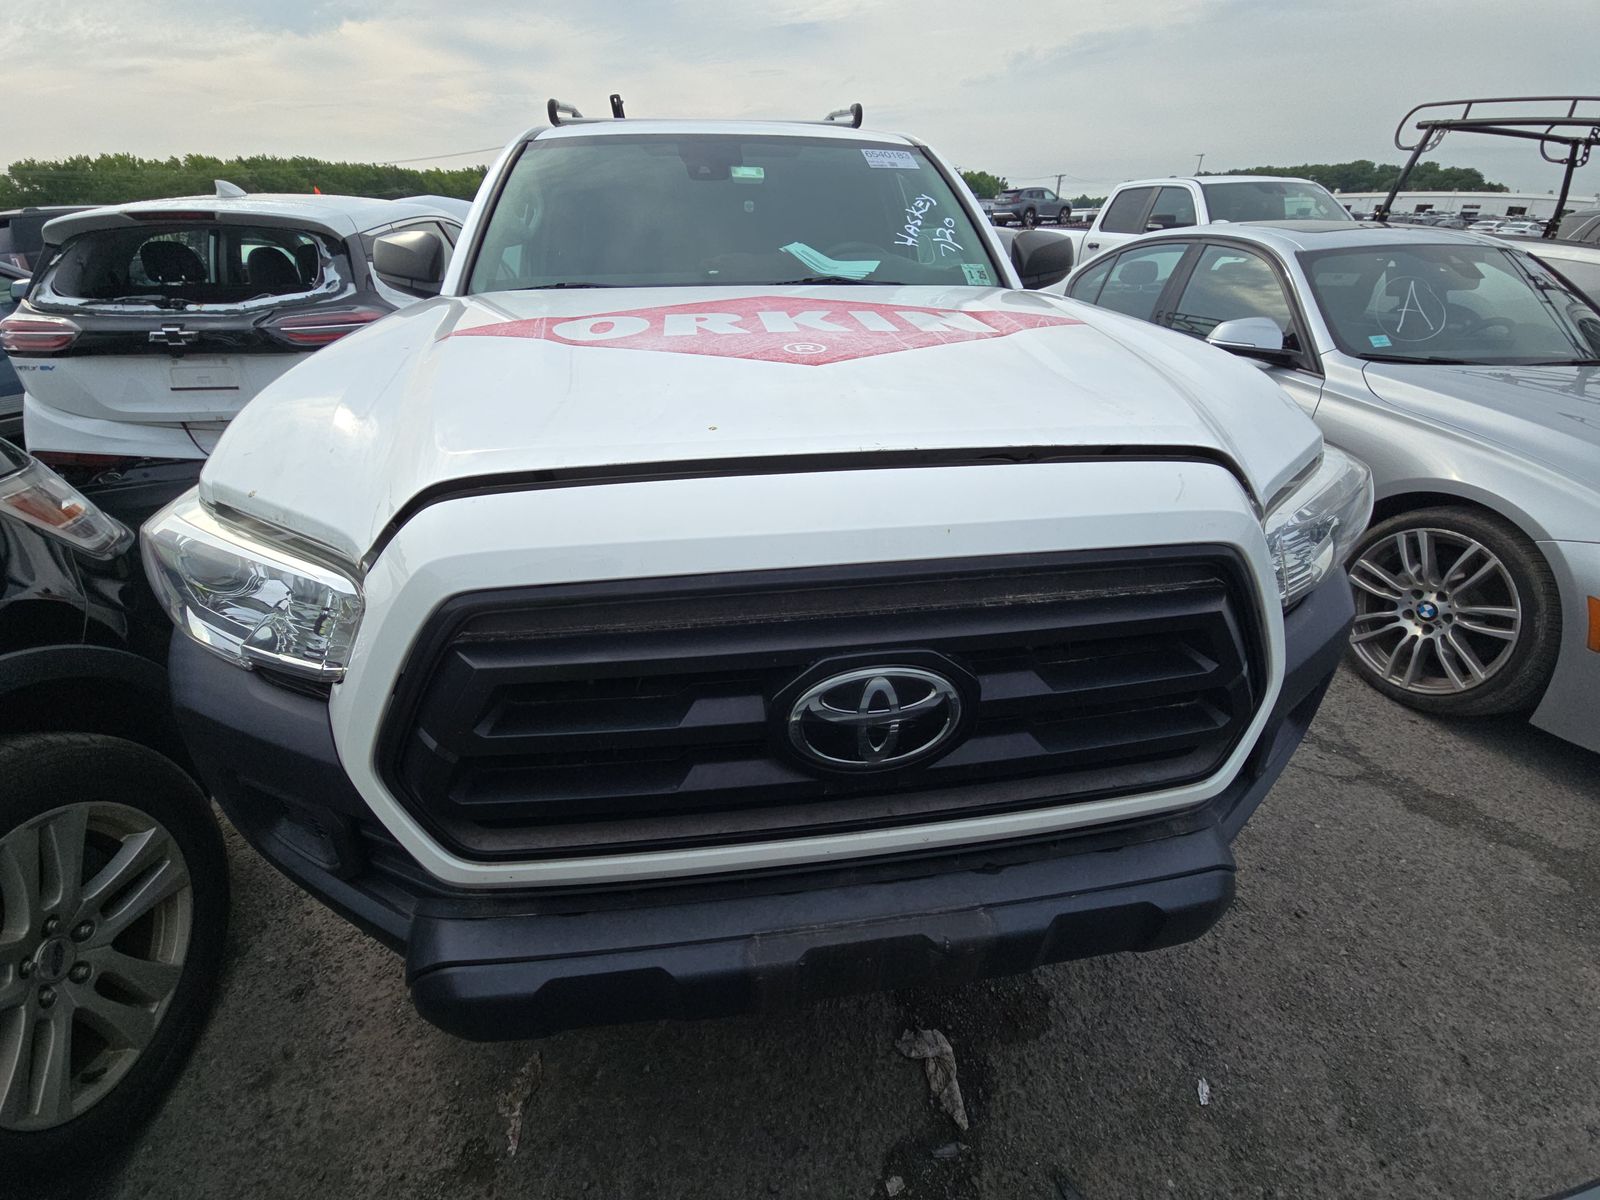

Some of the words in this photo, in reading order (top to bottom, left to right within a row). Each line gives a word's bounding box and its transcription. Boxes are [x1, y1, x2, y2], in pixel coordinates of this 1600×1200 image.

[932, 217, 964, 257] 7/20
[552, 310, 1000, 341] ORKIN
[1396, 280, 1435, 334] A
